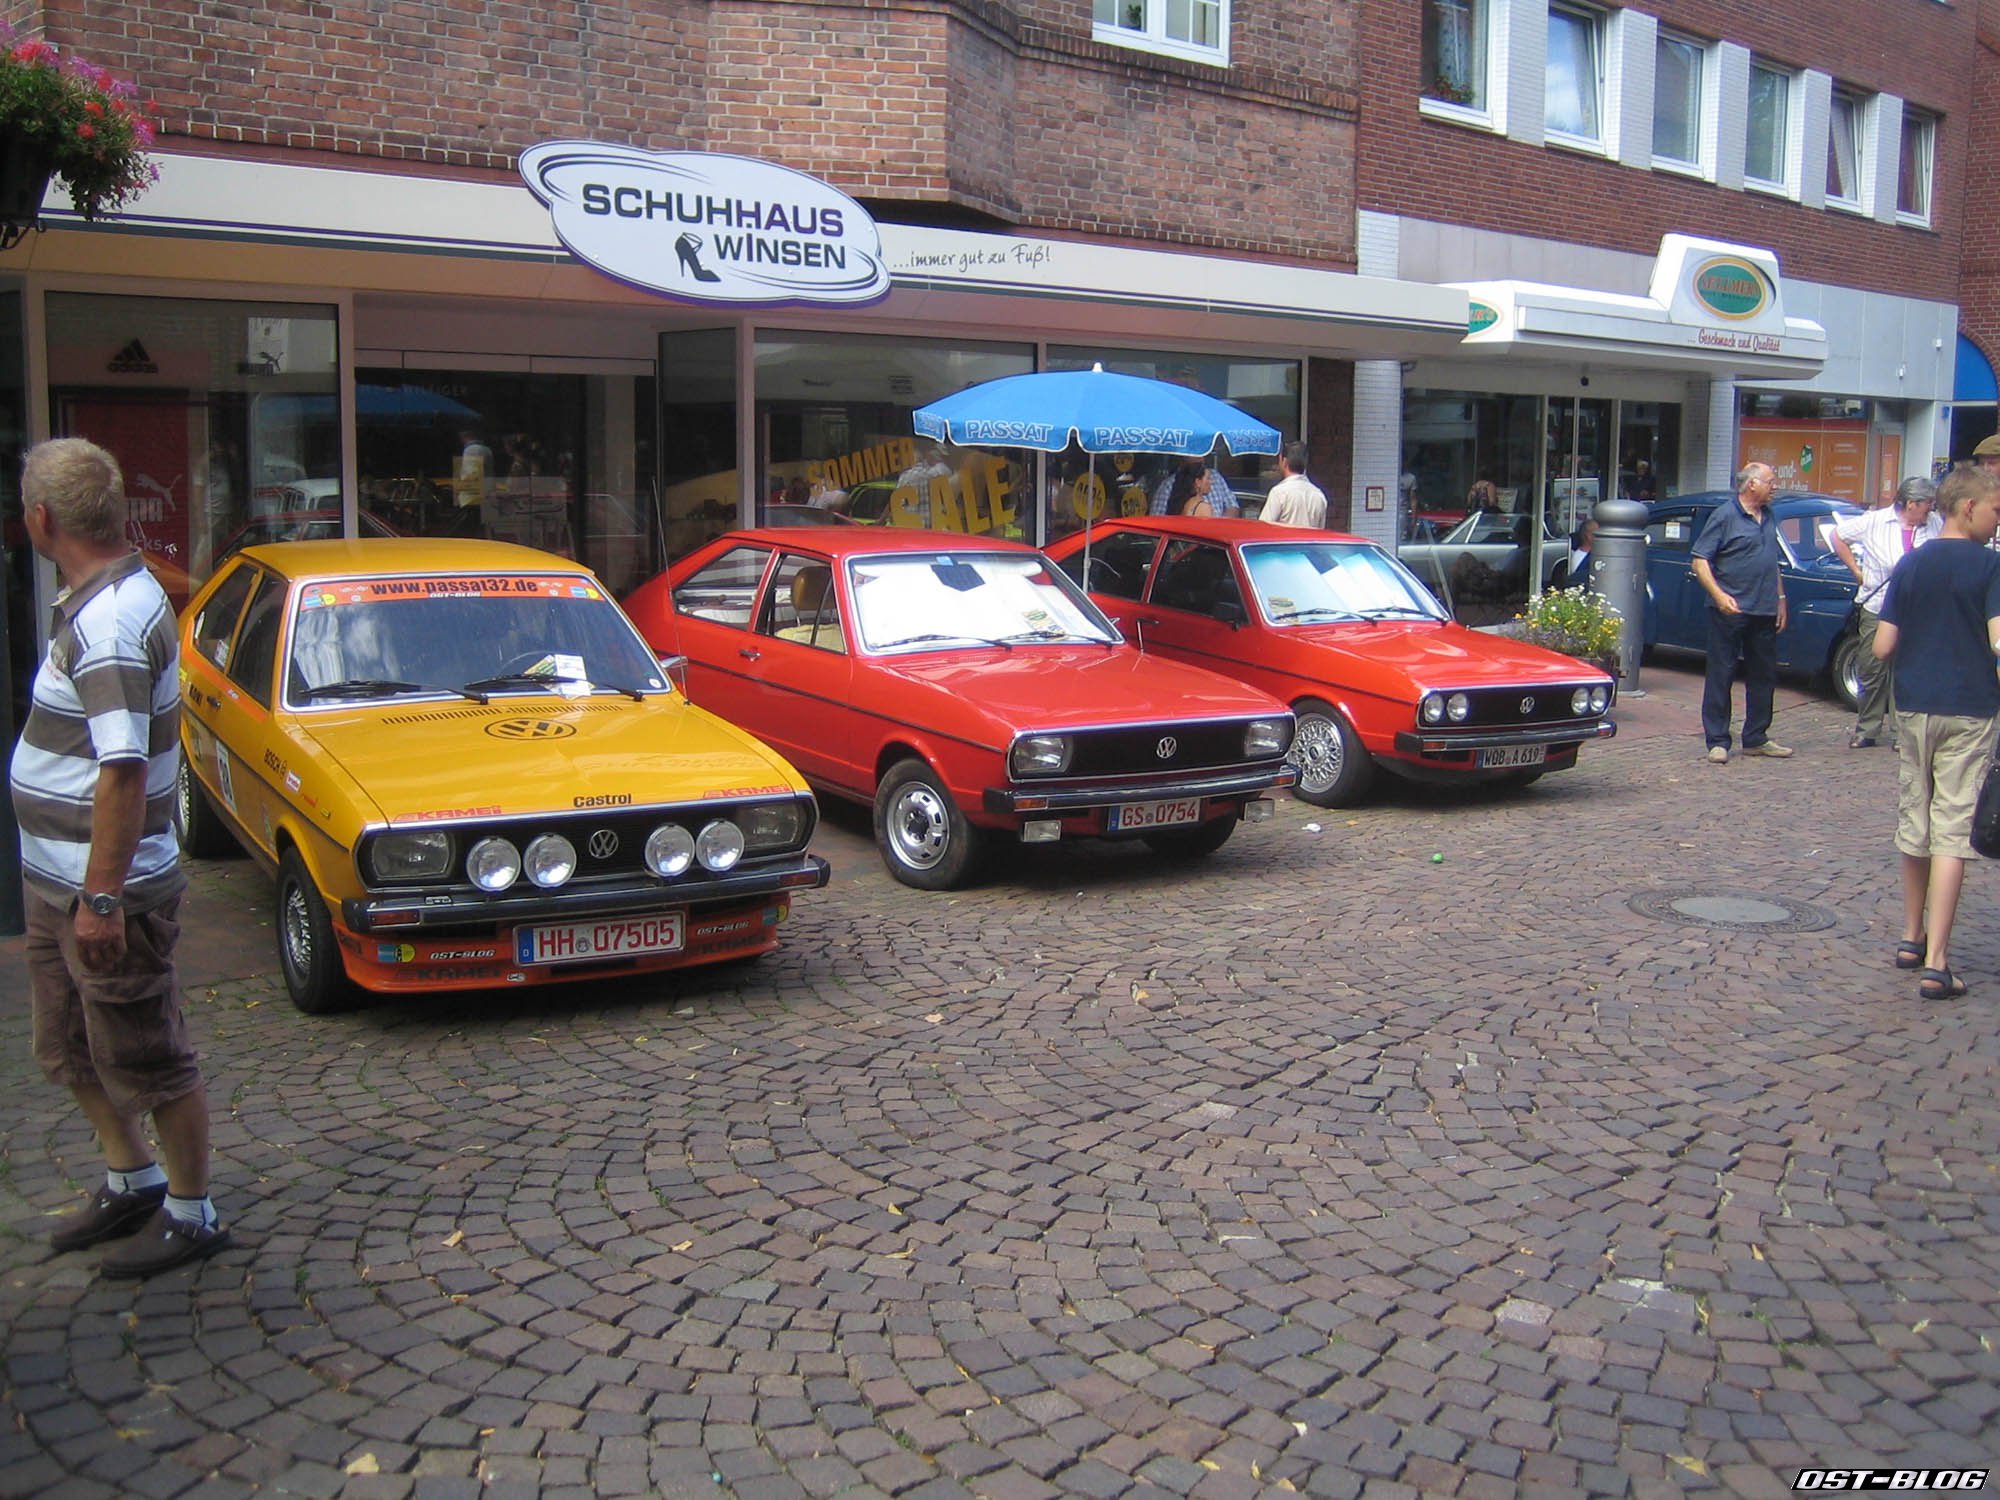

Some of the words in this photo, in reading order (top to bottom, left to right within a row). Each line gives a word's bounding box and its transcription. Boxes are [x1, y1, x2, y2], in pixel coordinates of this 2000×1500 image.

[582, 183, 844, 237] SCHUHHAUS
[713, 230, 846, 269] WINSEN
[958, 250, 985, 273] gut
[987, 251, 1006, 264] zu
[1010, 243, 1051, 269] Fuß!
[1738, 334, 1752, 349] und
[965, 419, 1054, 443] PASSAT
[1094, 427, 1194, 448] PASSAT
[806, 437, 917, 497] SOMMER
[889, 455, 1017, 534] SALE
[370, 579, 538, 594] www.passat32.de
[1484, 749, 1506, 767] WOB
[1511, 748, 1519, 765] A
[1521, 747, 1540, 764] 619
[573, 793, 632, 808] Castrol
[1122, 806, 1145, 827] GS
[1155, 801, 1197, 824] 0754
[539, 929, 574, 958] HH
[593, 919, 675, 952] 07505
[430, 949, 496, 960] OST-BLOG
